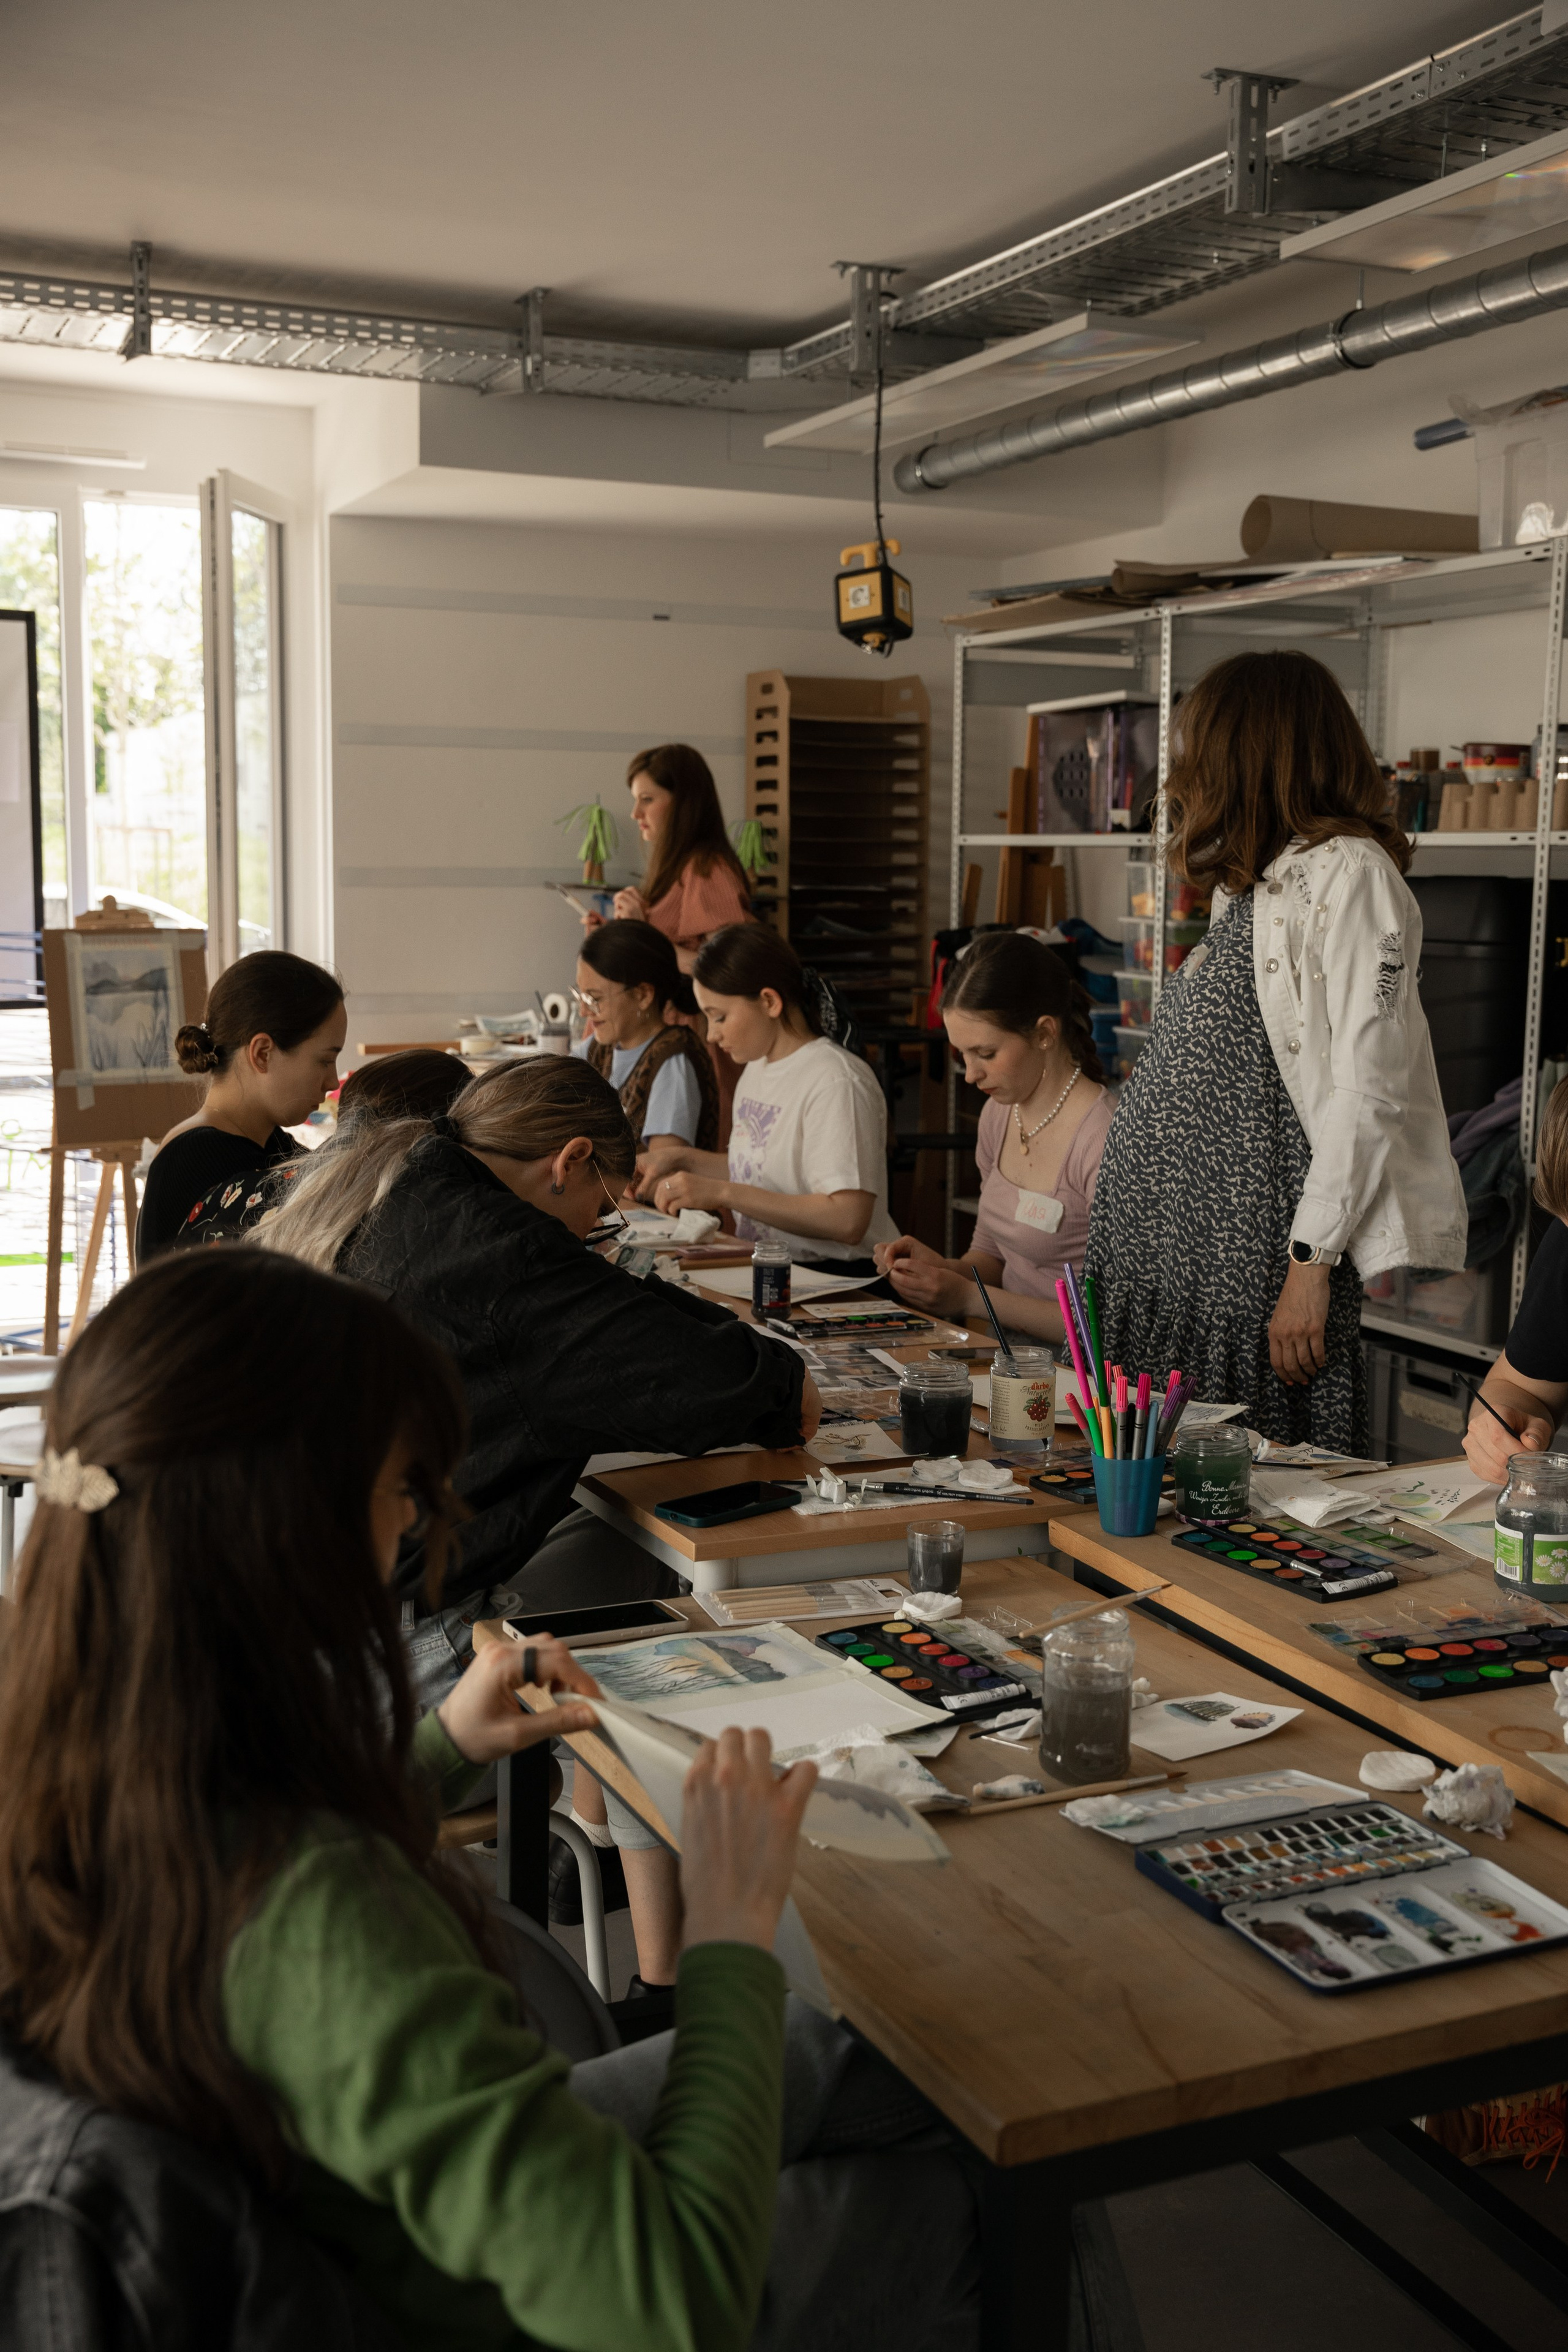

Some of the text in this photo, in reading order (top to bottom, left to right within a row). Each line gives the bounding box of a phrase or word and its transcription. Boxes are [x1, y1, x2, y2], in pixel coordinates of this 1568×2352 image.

[1201, 1480, 1225, 1492] Bonne
[1189, 1490, 1208, 1504] Weniger
[1212, 1503, 1240, 1515] Erdbeere
